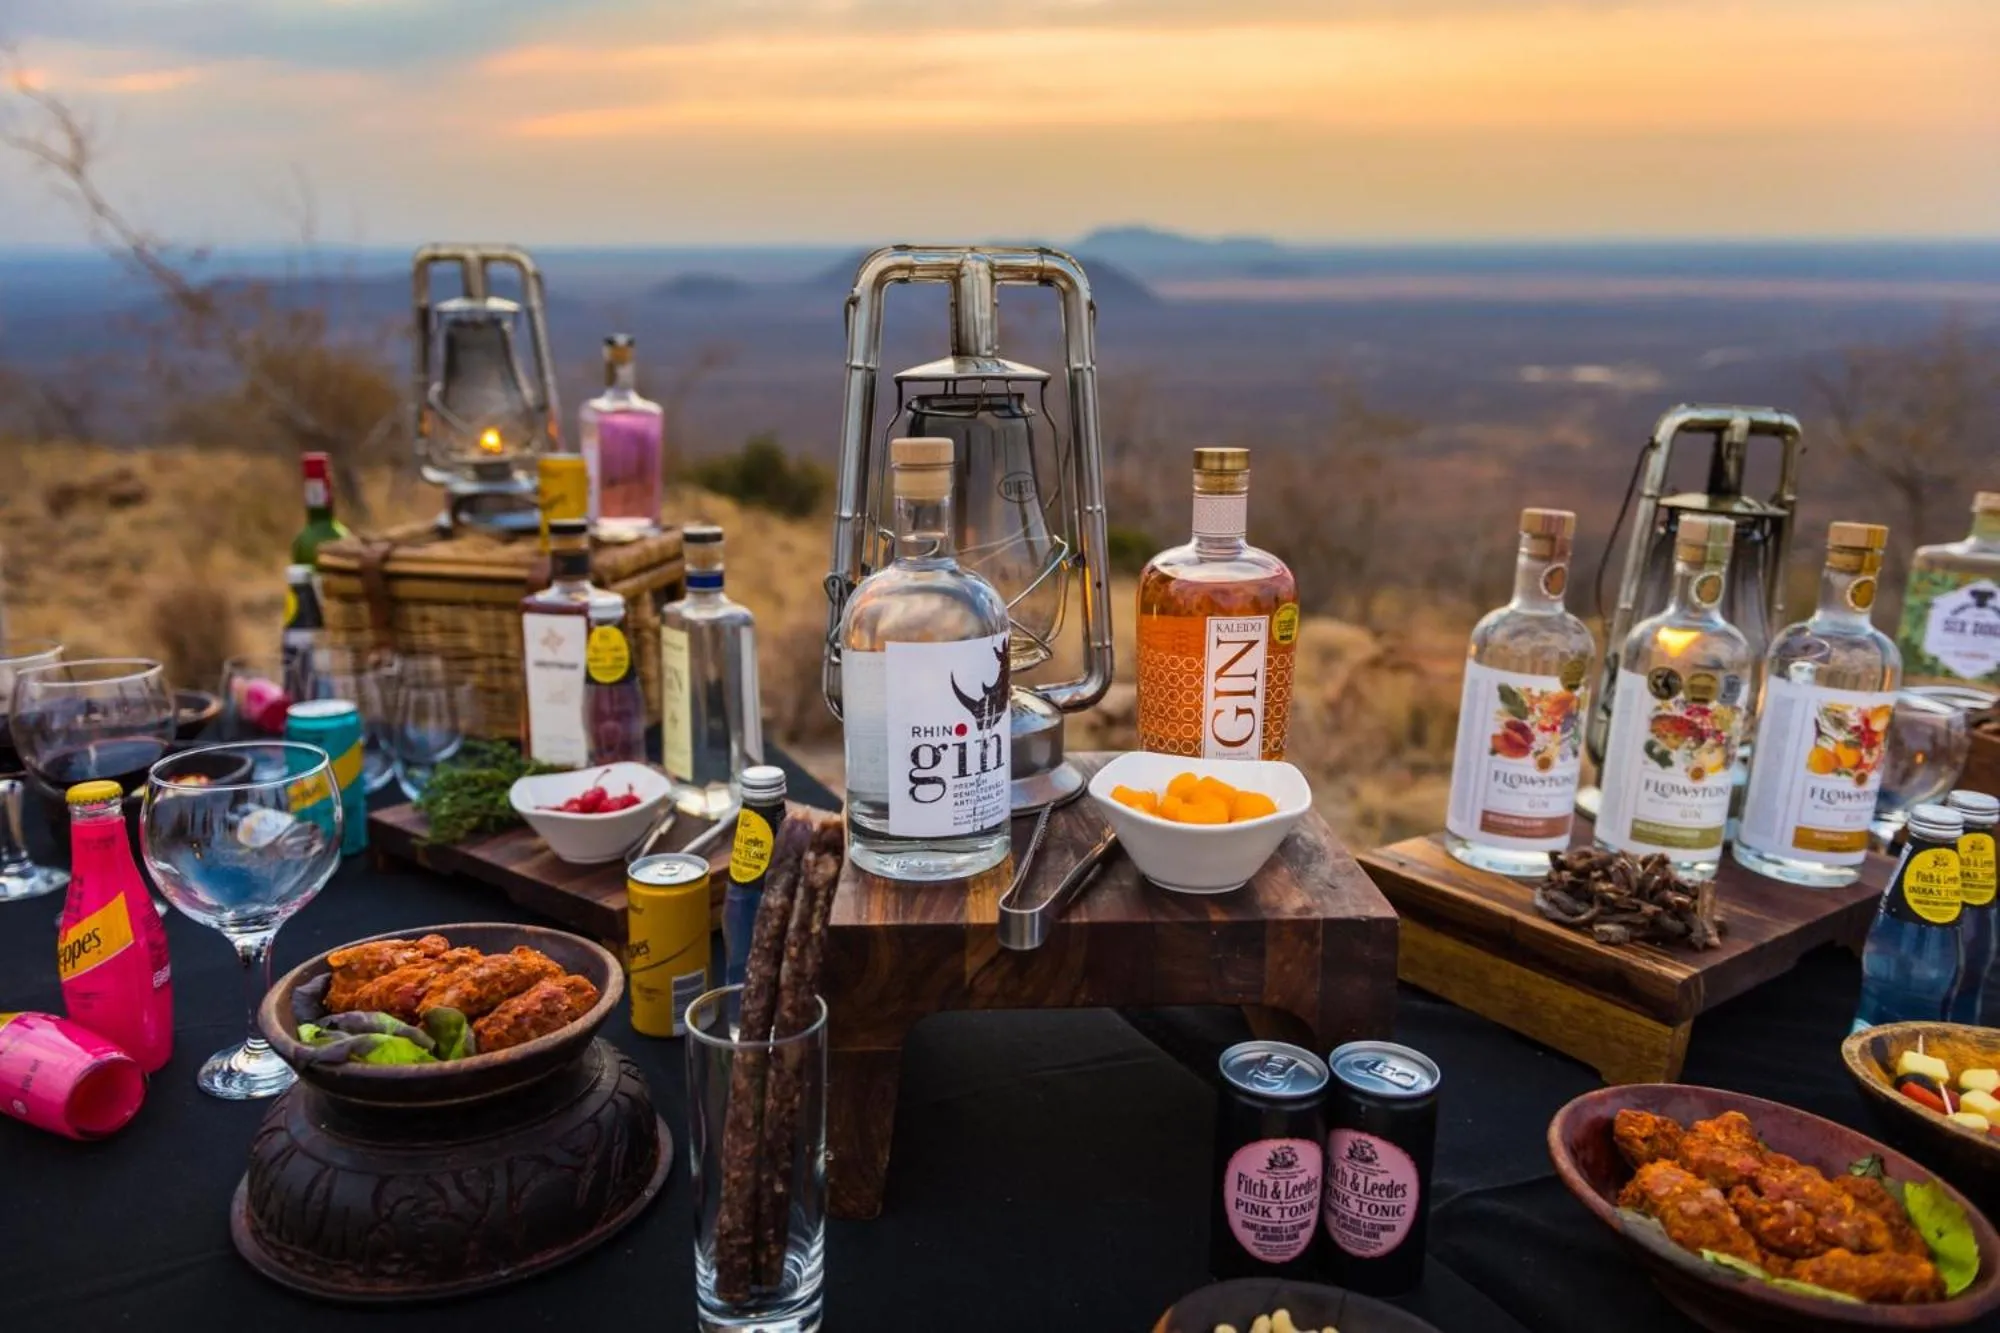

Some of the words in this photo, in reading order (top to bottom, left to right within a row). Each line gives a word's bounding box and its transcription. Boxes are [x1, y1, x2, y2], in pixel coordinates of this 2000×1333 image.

[1216, 621, 1262, 633] KALEIDO
[1211, 635, 1260, 749] GIN
[909, 733, 1005, 804] gin
[1237, 1172, 1269, 1199] Fitch
[1270, 1181, 1282, 1201] &
[1350, 1172, 1360, 1192] &
[1363, 1175, 1408, 1199] Leedes
[1235, 1197, 1273, 1219] PINK
[1355, 1199, 1407, 1217] TONIC
